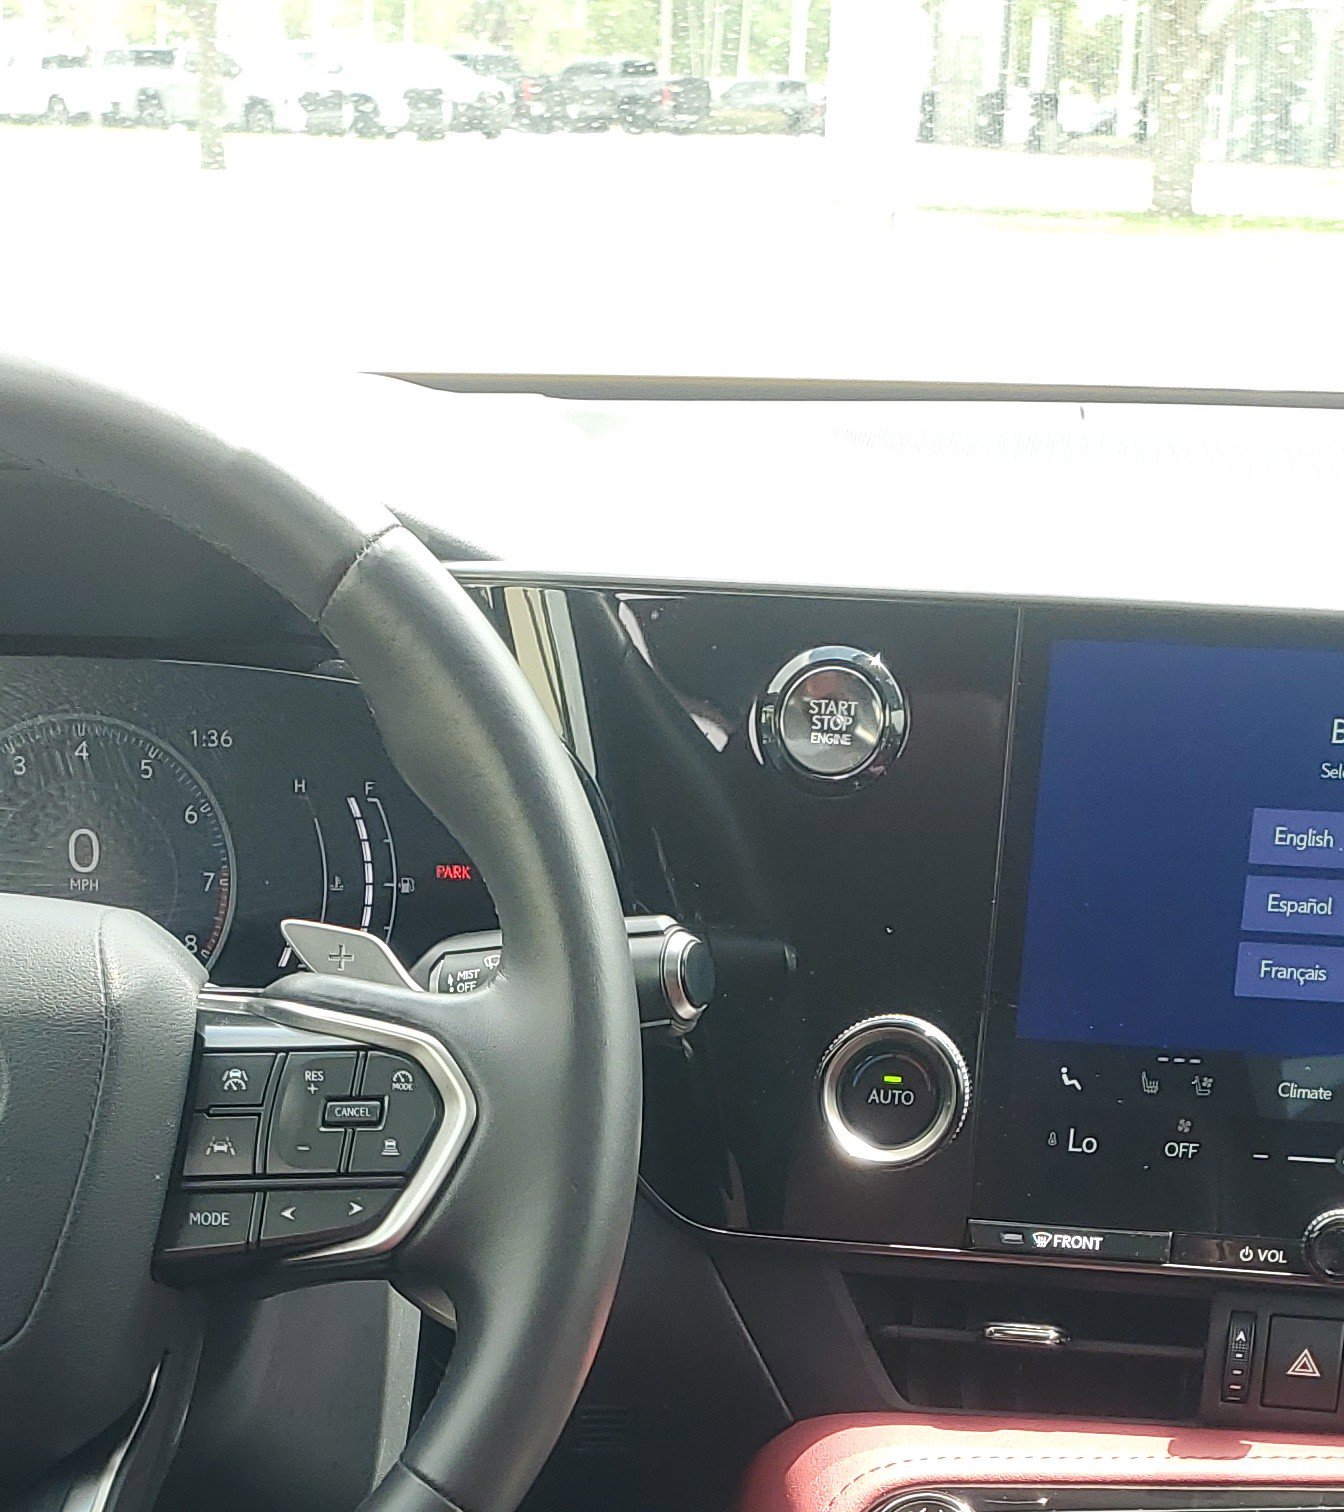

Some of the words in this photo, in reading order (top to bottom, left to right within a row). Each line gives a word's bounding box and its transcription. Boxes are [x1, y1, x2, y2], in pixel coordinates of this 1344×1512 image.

[808, 699, 858, 716] START
[811, 715, 853, 731] STOP
[190, 729, 233, 748] 1:36
[810, 732, 852, 746] ENGINE
[74, 740, 89, 760] 4
[13, 755, 26, 776] 3
[140, 760, 153, 779] 5
[293, 778, 307, 794] H
[364, 781, 375, 796] F
[184, 804, 198, 824] 6
[1273, 826, 1334, 851] English
[68, 828, 100, 874] 0
[435, 864, 472, 881] PARK
[69, 878, 99, 891] MPH
[202, 872, 215, 892] 7
[1267, 893, 1333, 918] Español
[184, 934, 198, 955] 8
[456, 968, 481, 981] MIST
[1259, 959, 1327, 986] Français
[304, 1070, 325, 1082] RES
[867, 1089, 915, 1107] AUTO
[1276, 1081, 1333, 1103] Climate
[334, 1107, 371, 1117] CANCEL
[1067, 1127, 1098, 1154] Lo
[1164, 1141, 1200, 1159] OFF
[189, 1212, 230, 1227] MODE
[1052, 1233, 1103, 1251] FRONT
[1257, 1248, 1288, 1264] VOL
